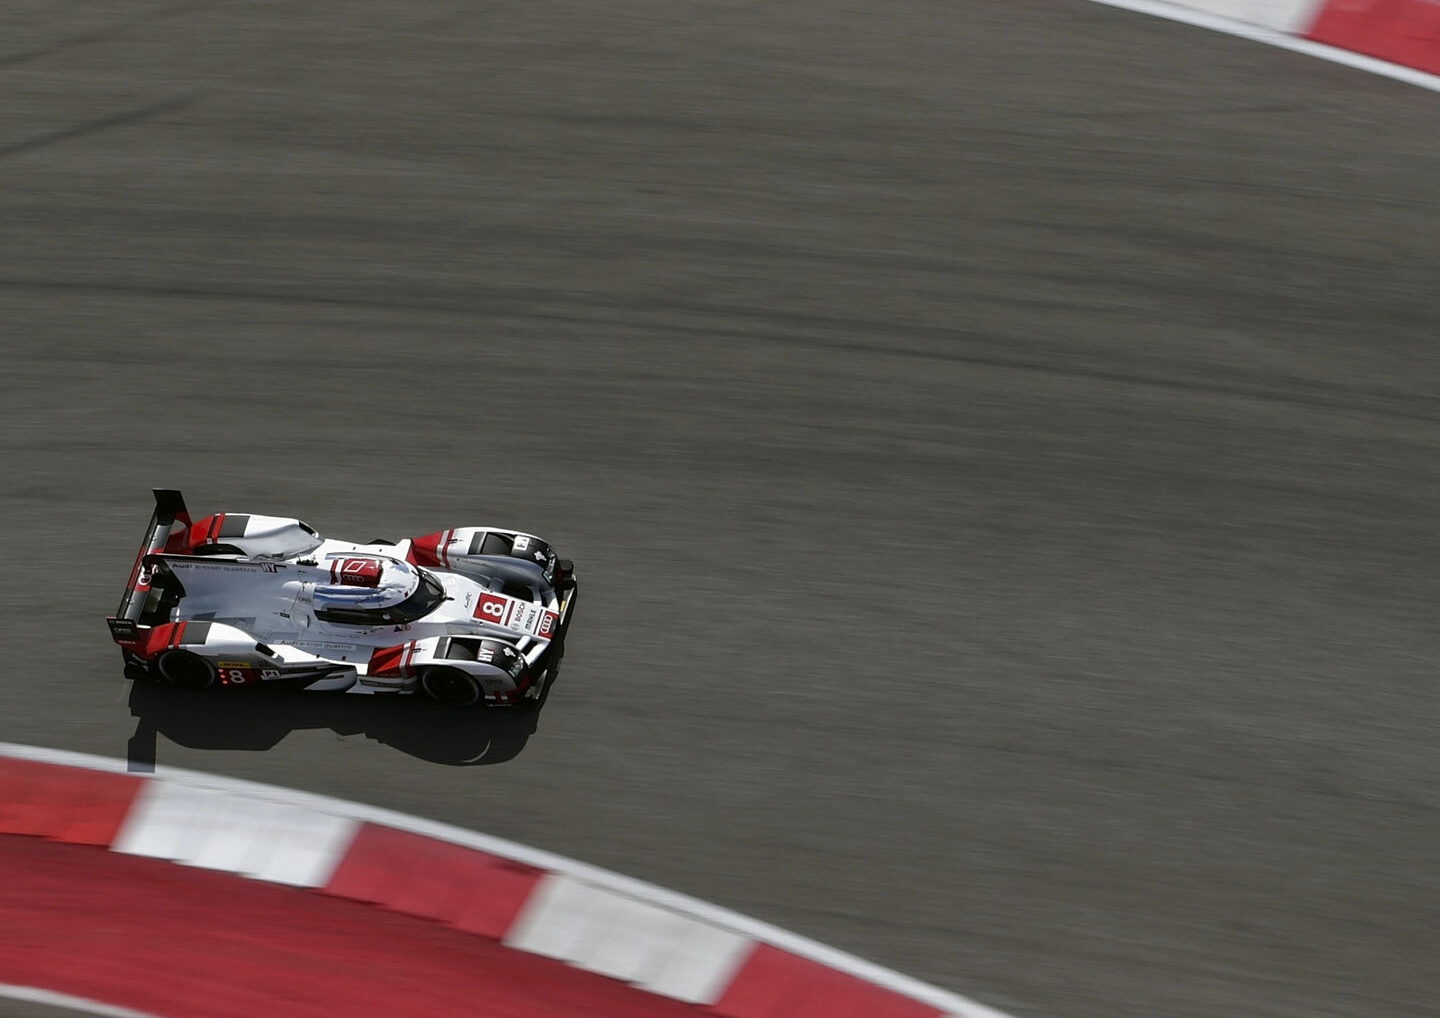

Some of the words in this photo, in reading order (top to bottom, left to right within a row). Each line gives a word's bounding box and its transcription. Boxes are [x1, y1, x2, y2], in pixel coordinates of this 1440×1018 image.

[261, 562, 277, 573] HY
[483, 601, 504, 617] 8
[514, 601, 526, 622] BOSCH
[525, 609, 537, 630] MAHLE
[478, 648, 494, 662] HY
[229, 669, 246, 684] 8
